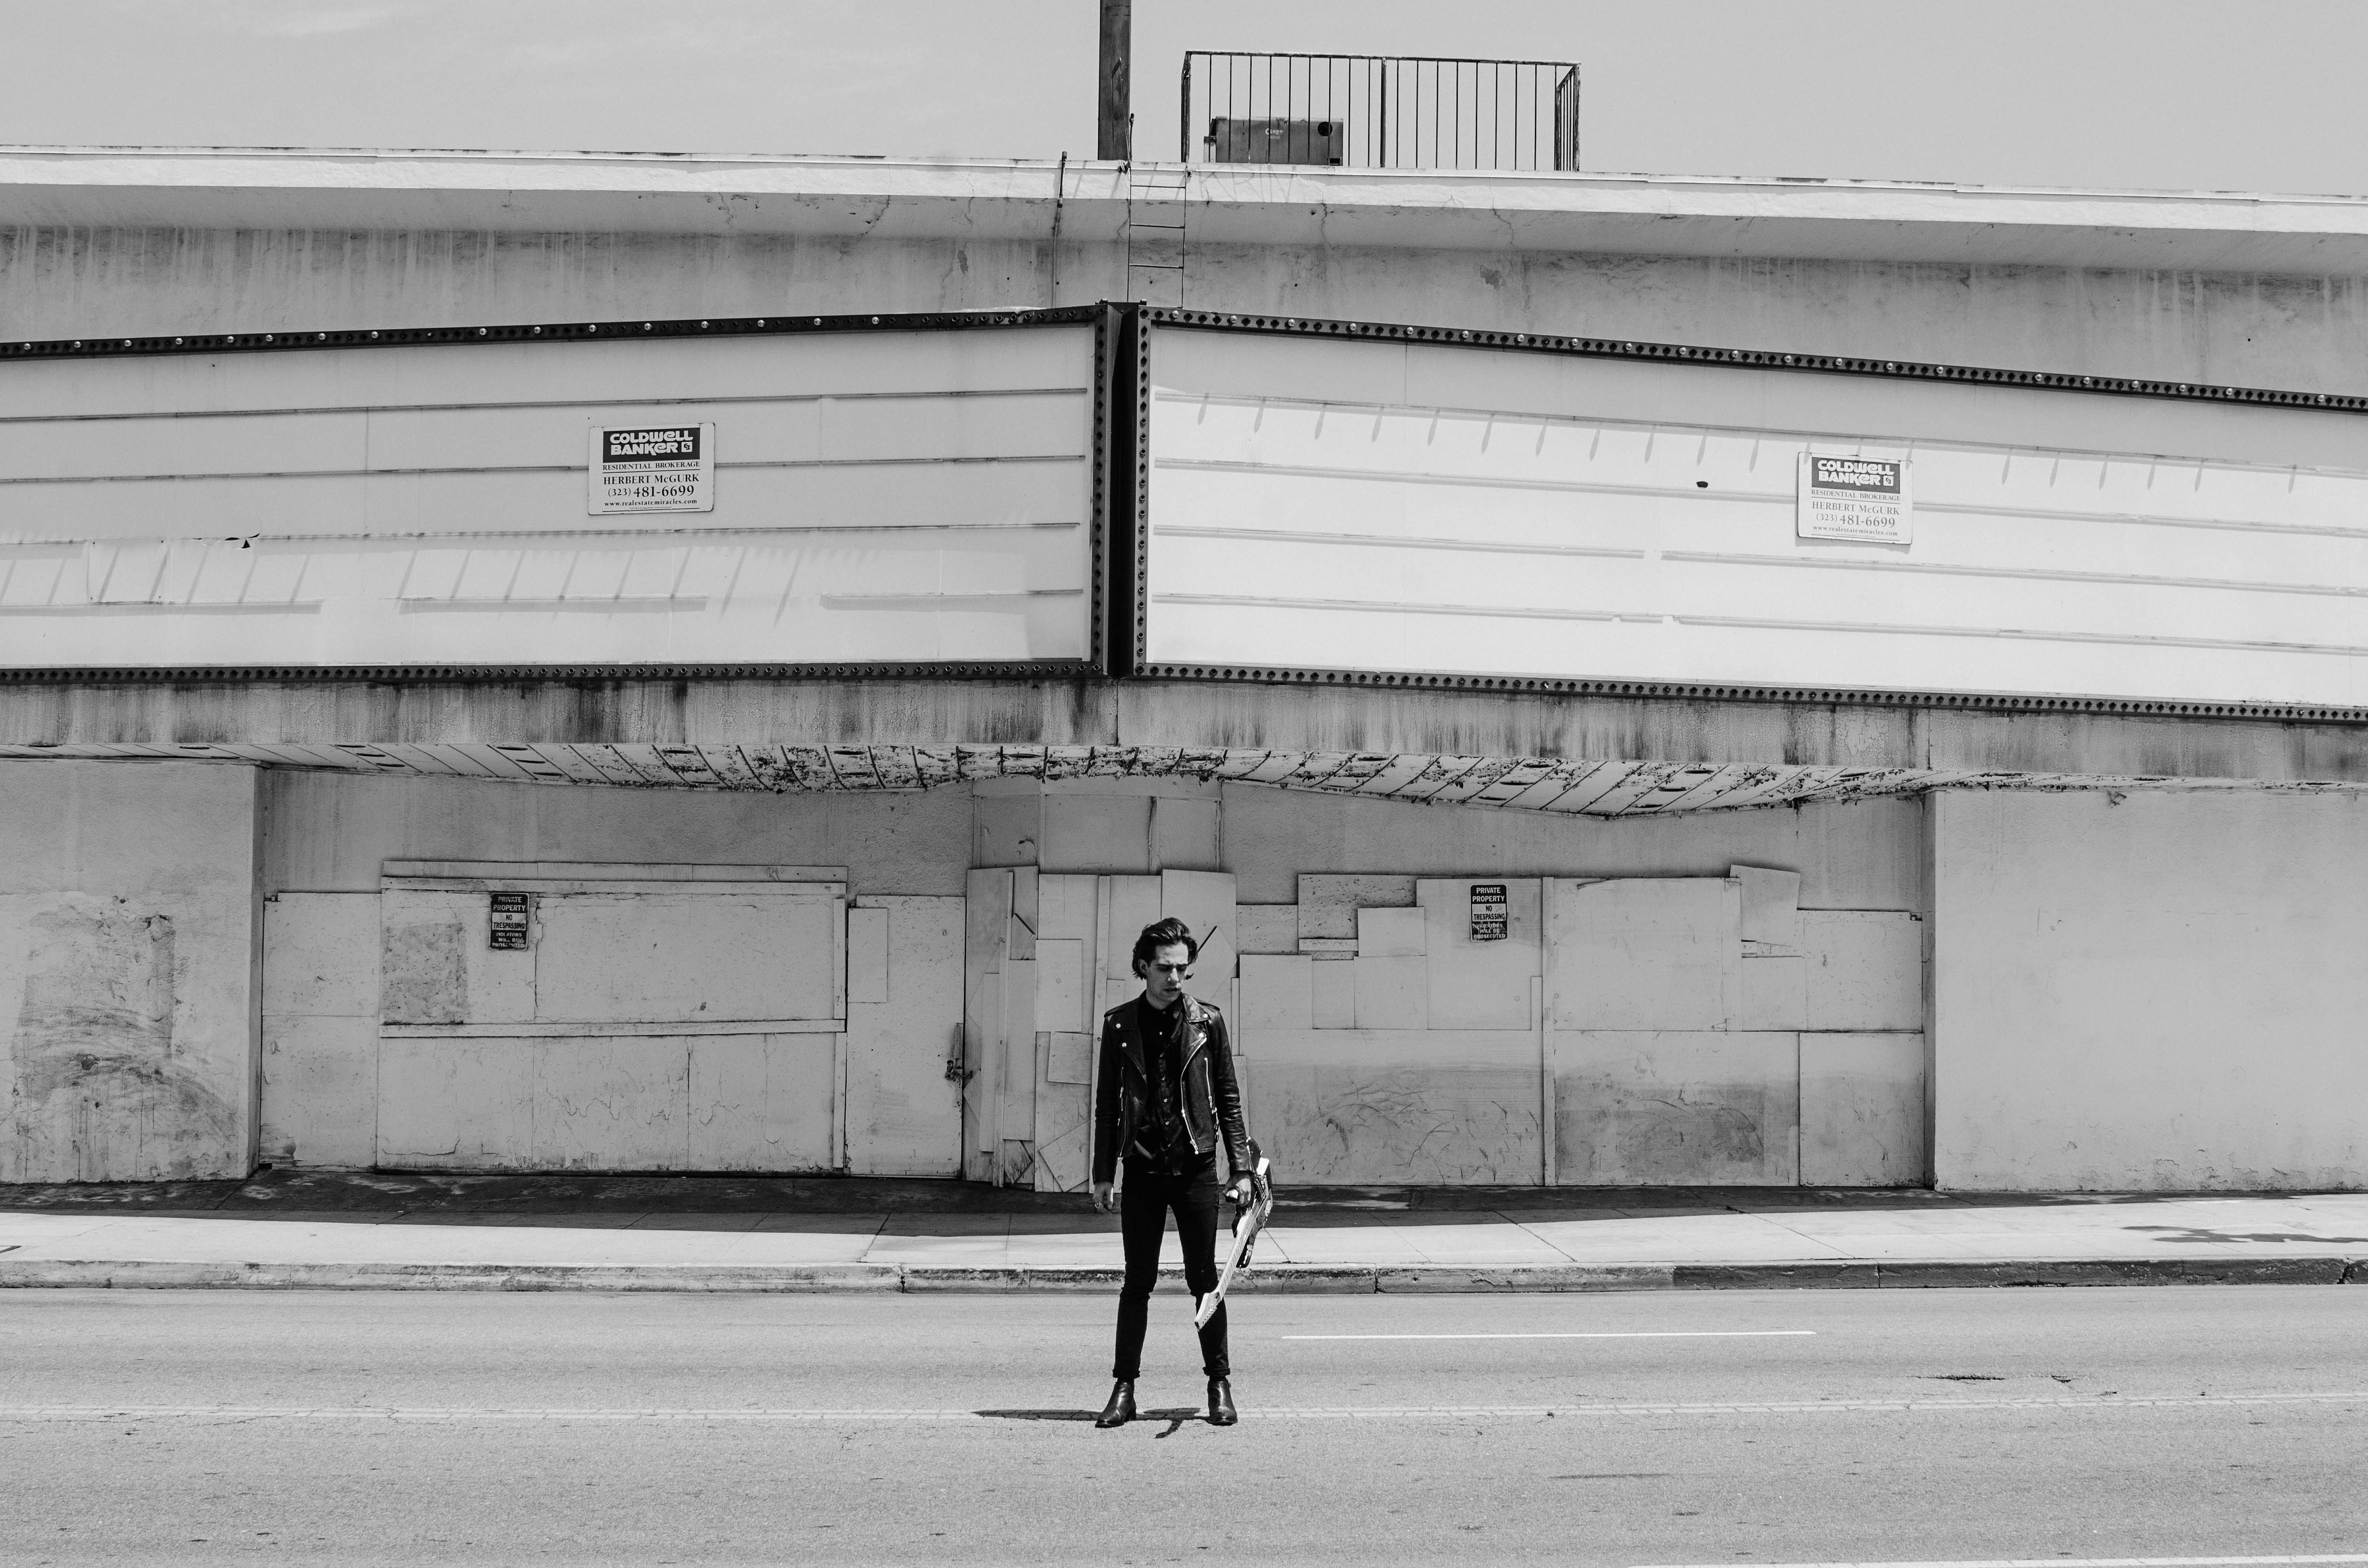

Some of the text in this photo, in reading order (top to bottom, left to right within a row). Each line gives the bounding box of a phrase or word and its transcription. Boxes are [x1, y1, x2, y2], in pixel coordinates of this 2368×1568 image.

[604, 474, 699, 485] HERBERT McGURK
[608, 485, 694, 498] (323) 481-6699
[1811, 489, 1900, 501] RESIDENTIAL BROKERAGE
[1812, 501, 1899, 515] HERBERT McGURK
[1816, 512, 1895, 528] (323) 481-6699
[1813, 526, 1898, 536] www.realestatemiracles.com
